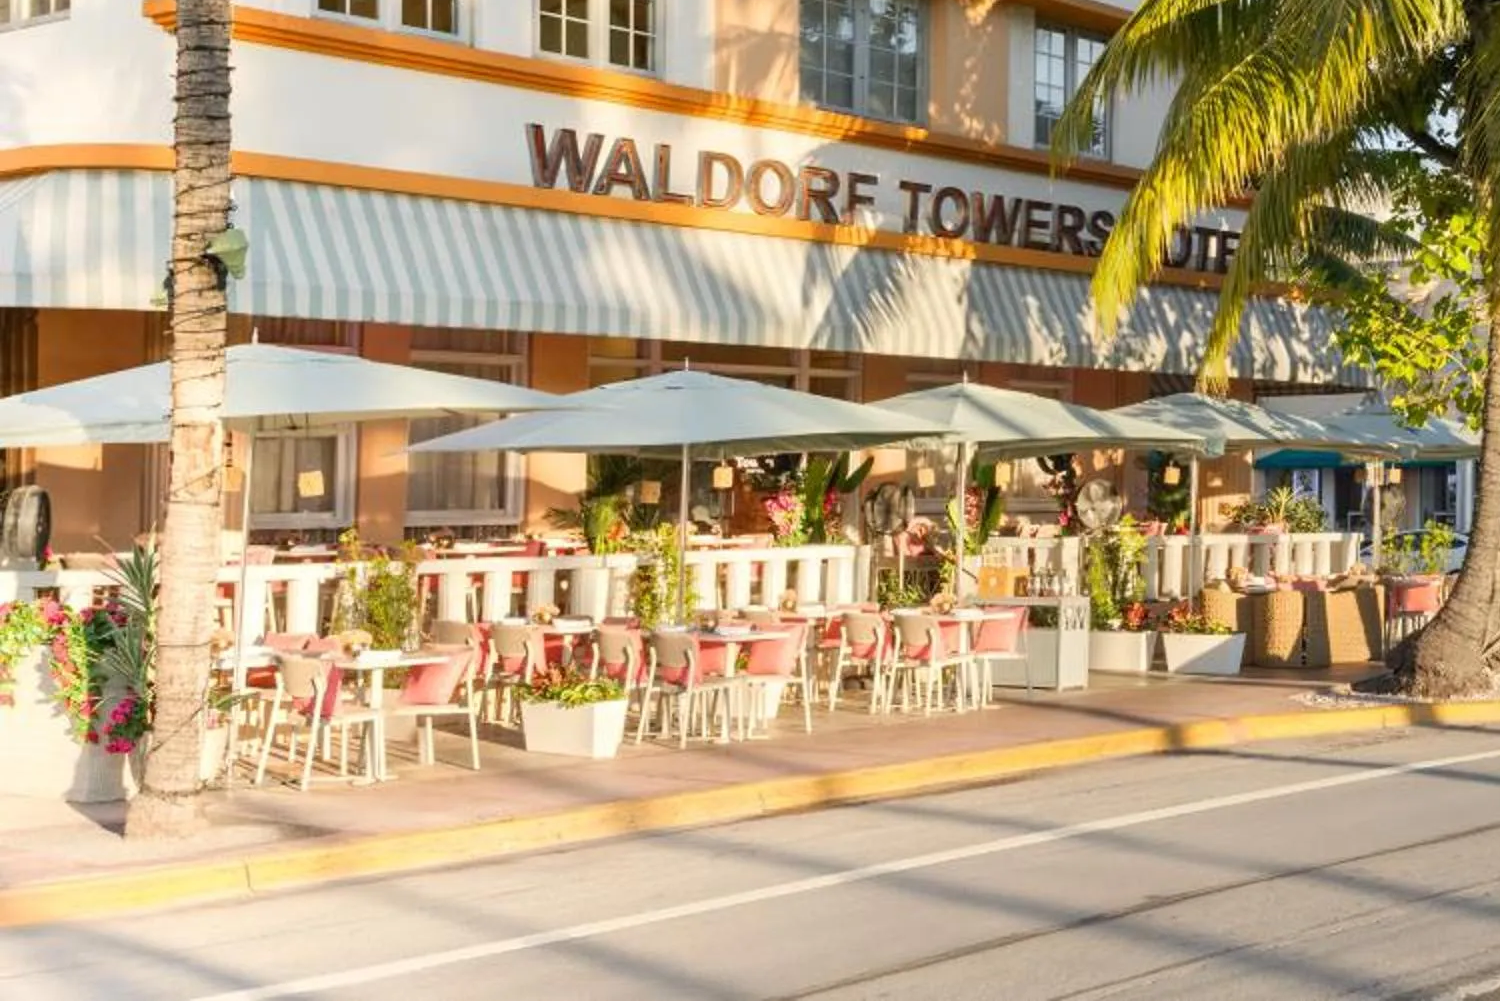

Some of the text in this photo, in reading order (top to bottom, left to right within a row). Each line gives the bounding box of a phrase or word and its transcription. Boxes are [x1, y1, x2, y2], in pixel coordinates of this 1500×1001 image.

[525, 122, 1244, 274] WALDORF TOWERS OTE
